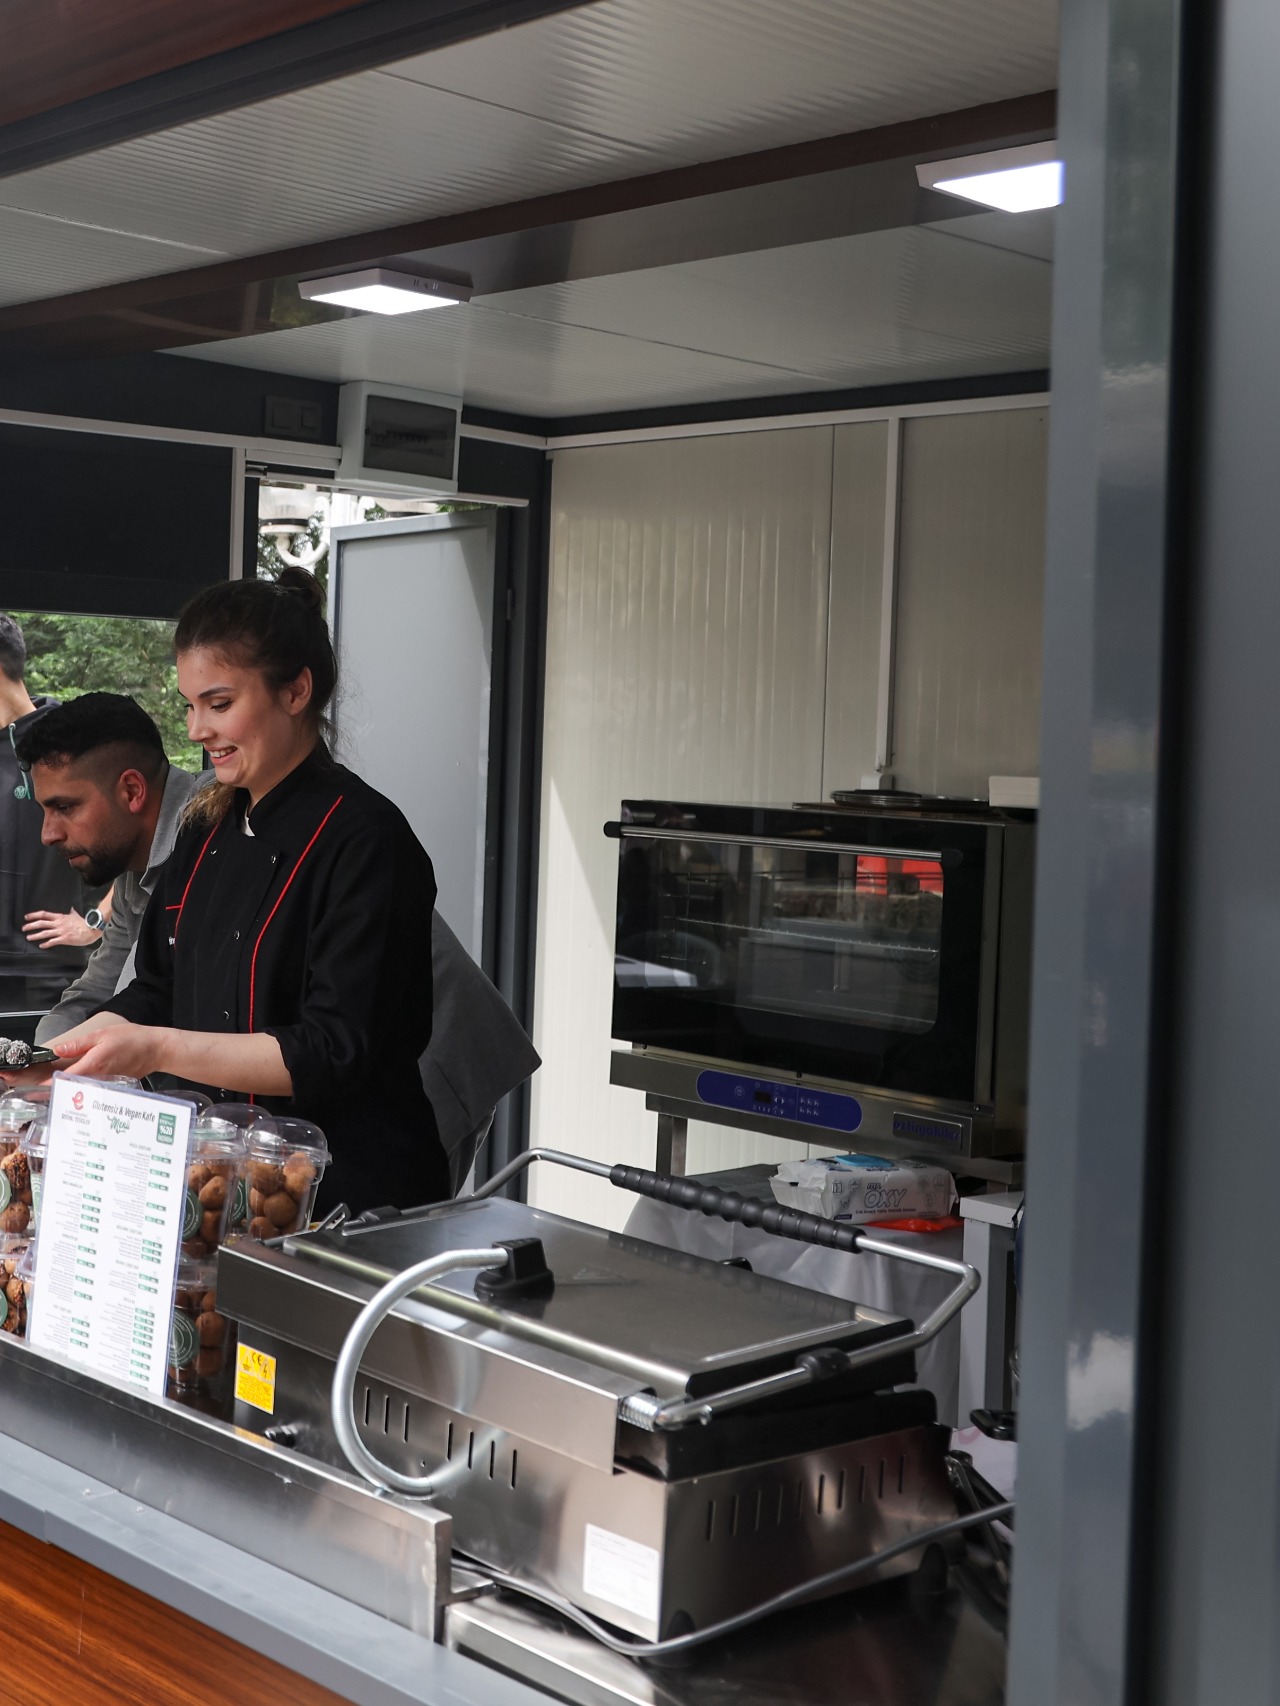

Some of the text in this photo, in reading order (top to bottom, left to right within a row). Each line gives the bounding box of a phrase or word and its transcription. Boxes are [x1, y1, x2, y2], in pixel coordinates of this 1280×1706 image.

[92, 1100, 119, 1115] Glutensiz
[124, 1108, 142, 1120] Vegan
[142, 1111, 156, 1122] Kafe
[864, 1188, 908, 1209] OXY
